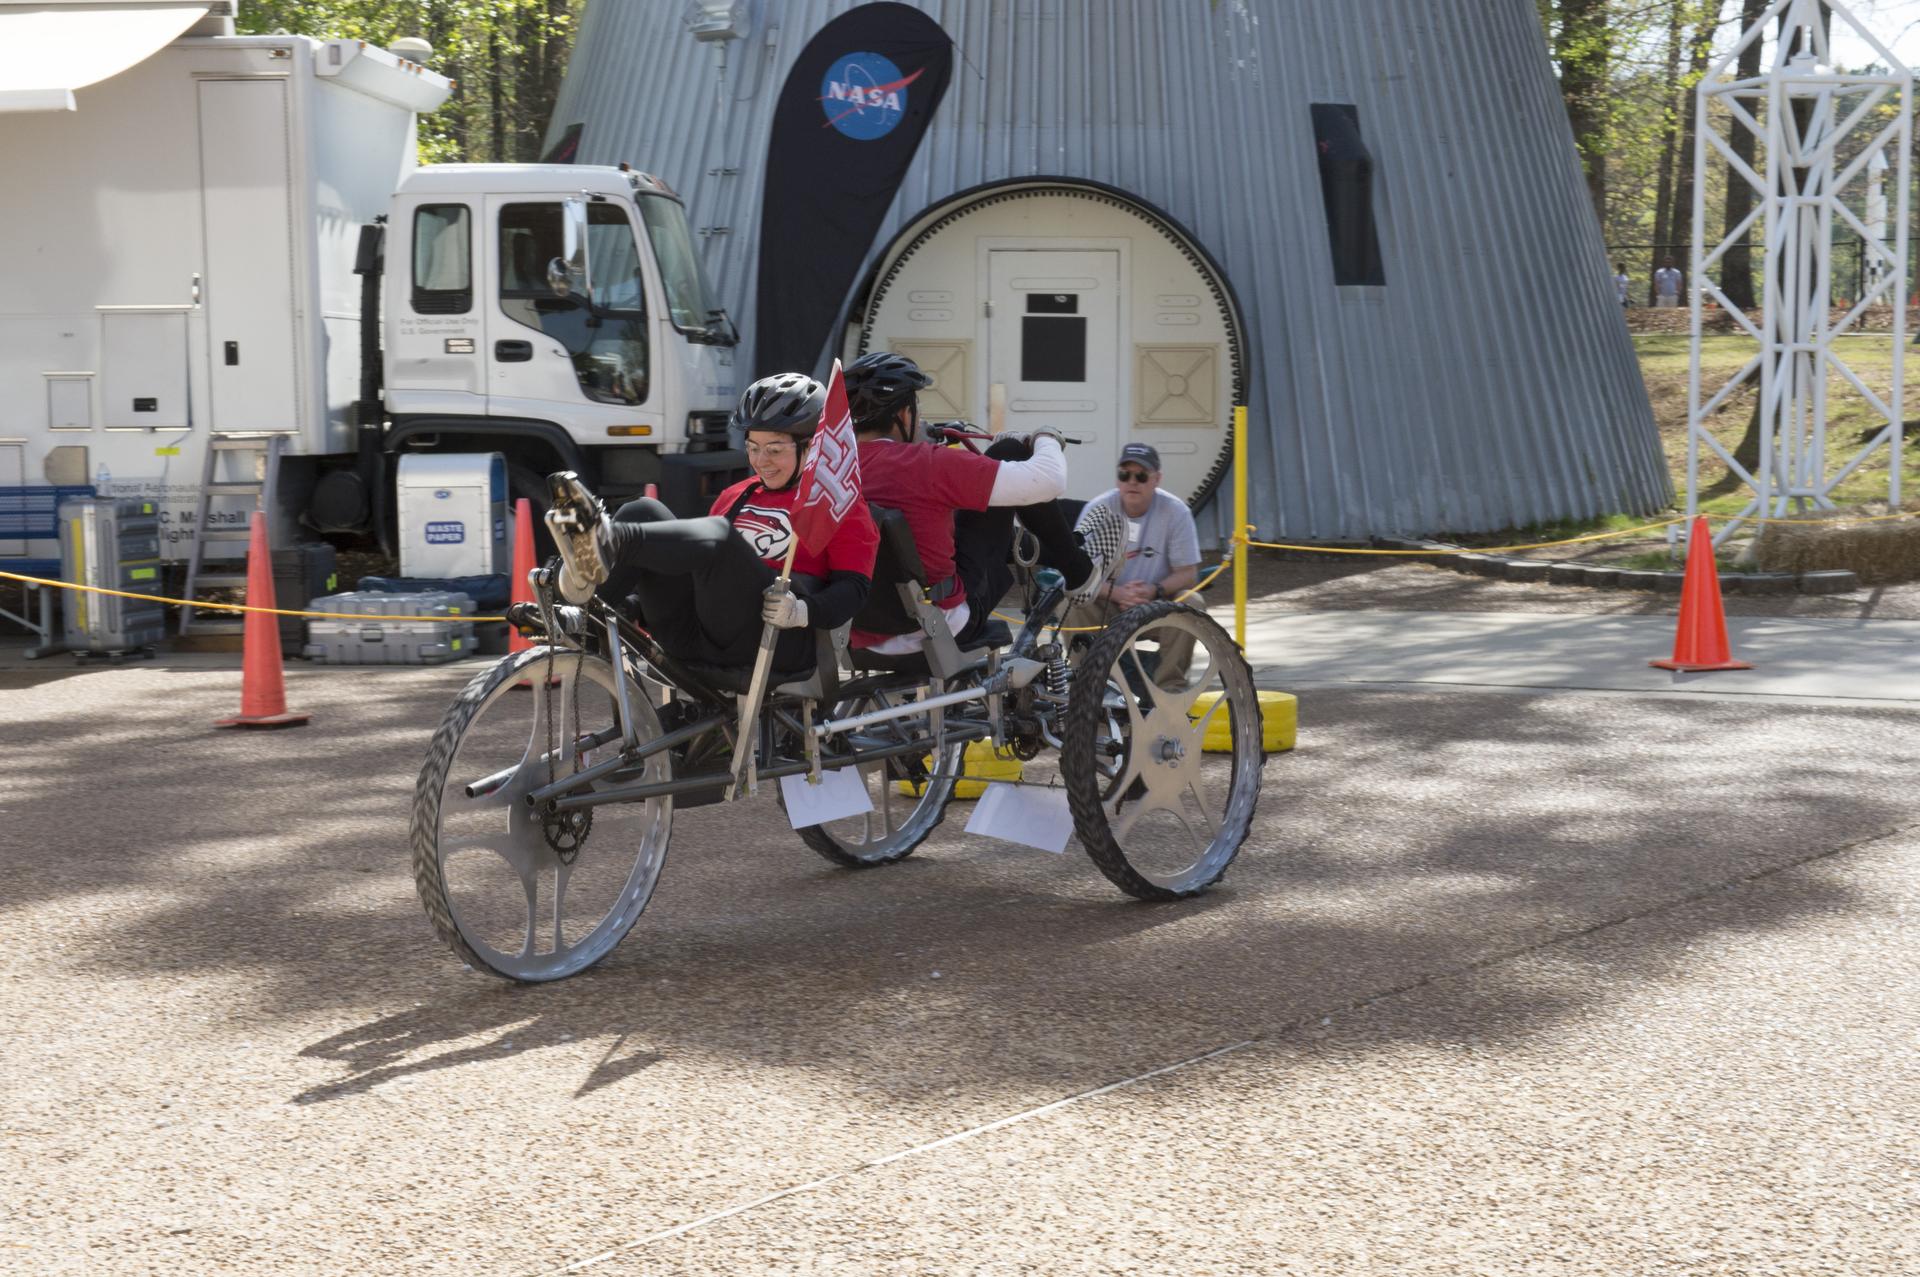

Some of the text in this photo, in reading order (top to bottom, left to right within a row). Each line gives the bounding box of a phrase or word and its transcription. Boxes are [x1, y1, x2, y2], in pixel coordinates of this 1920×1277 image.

[828, 81, 901, 111] NASA
[400, 318, 414, 326] For
[416, 318, 442, 326] Official
[426, 524, 464, 533] WASTE
[160, 528, 195, 543] light
[427, 533, 463, 541] PAPER
